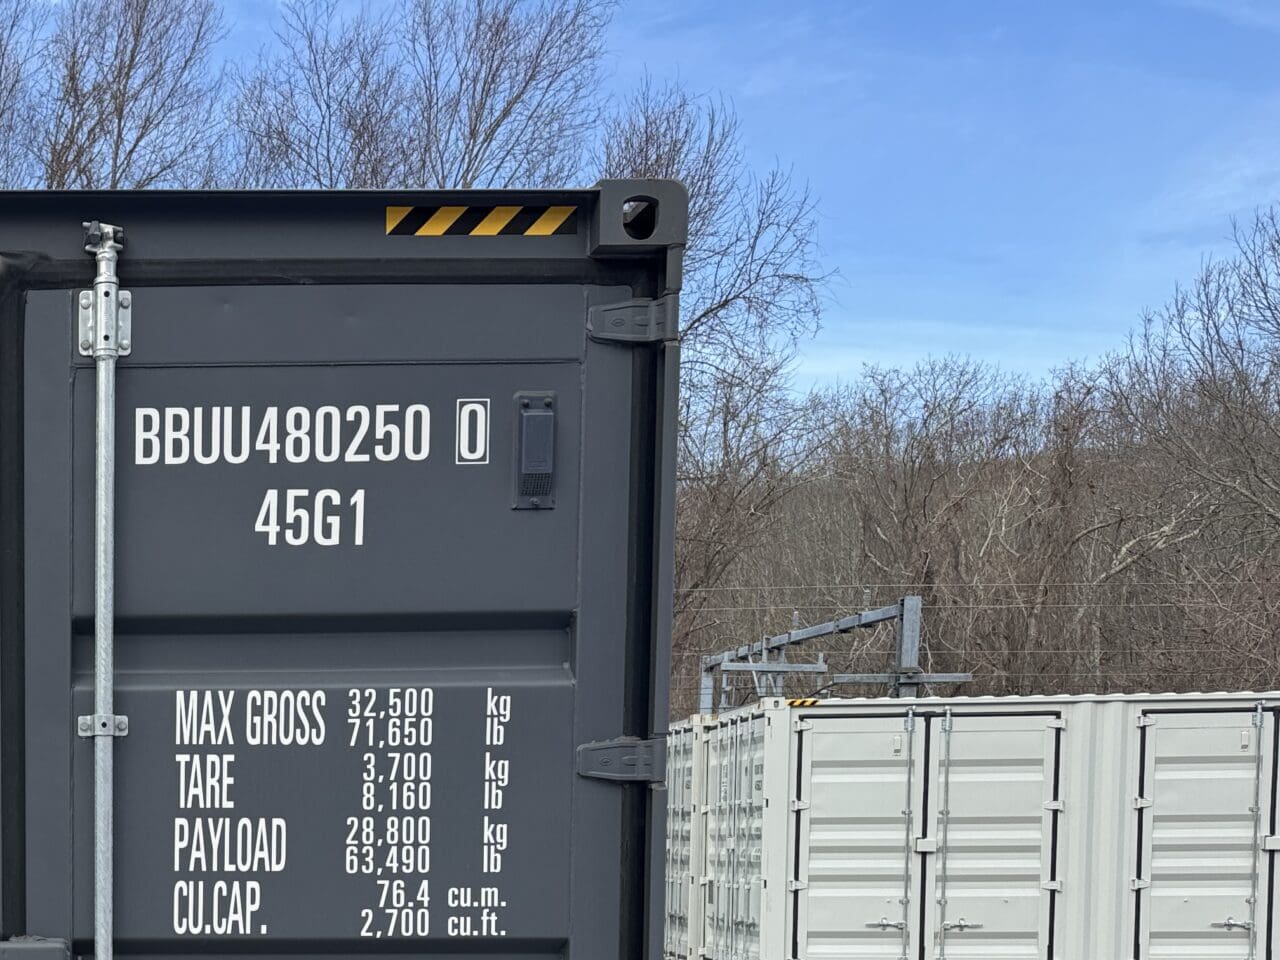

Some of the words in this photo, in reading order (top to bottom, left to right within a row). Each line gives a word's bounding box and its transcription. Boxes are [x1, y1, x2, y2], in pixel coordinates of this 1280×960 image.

[135, 404, 431, 465] BBUU480250
[459, 403, 486, 460] 0
[254, 488, 366, 547] 45G1
[175, 690, 235, 745] MAX
[246, 690, 326, 745] GROSS
[348, 688, 434, 719] 32,500
[486, 688, 512, 722] kg
[347, 718, 433, 748] 71,650
[486, 718, 505, 746] lb
[175, 754, 235, 809] TARE
[362, 752, 432, 783] 3,700
[484, 752, 510, 786] kg
[362, 782, 432, 812] 8,160
[484, 782, 504, 810] lb
[174, 818, 287, 872] PAYLOAD
[346, 816, 431, 846] 28,800
[482, 816, 508, 850] kg
[345, 846, 430, 876] 63,490
[482, 845, 502, 874] lb
[173, 880, 268, 935] CU.CAP.
[376, 880, 430, 908] 76.4
[447, 887, 507, 908] cu.m.
[360, 908, 430, 939] 2,700
[447, 910, 506, 937] cu.ft.
